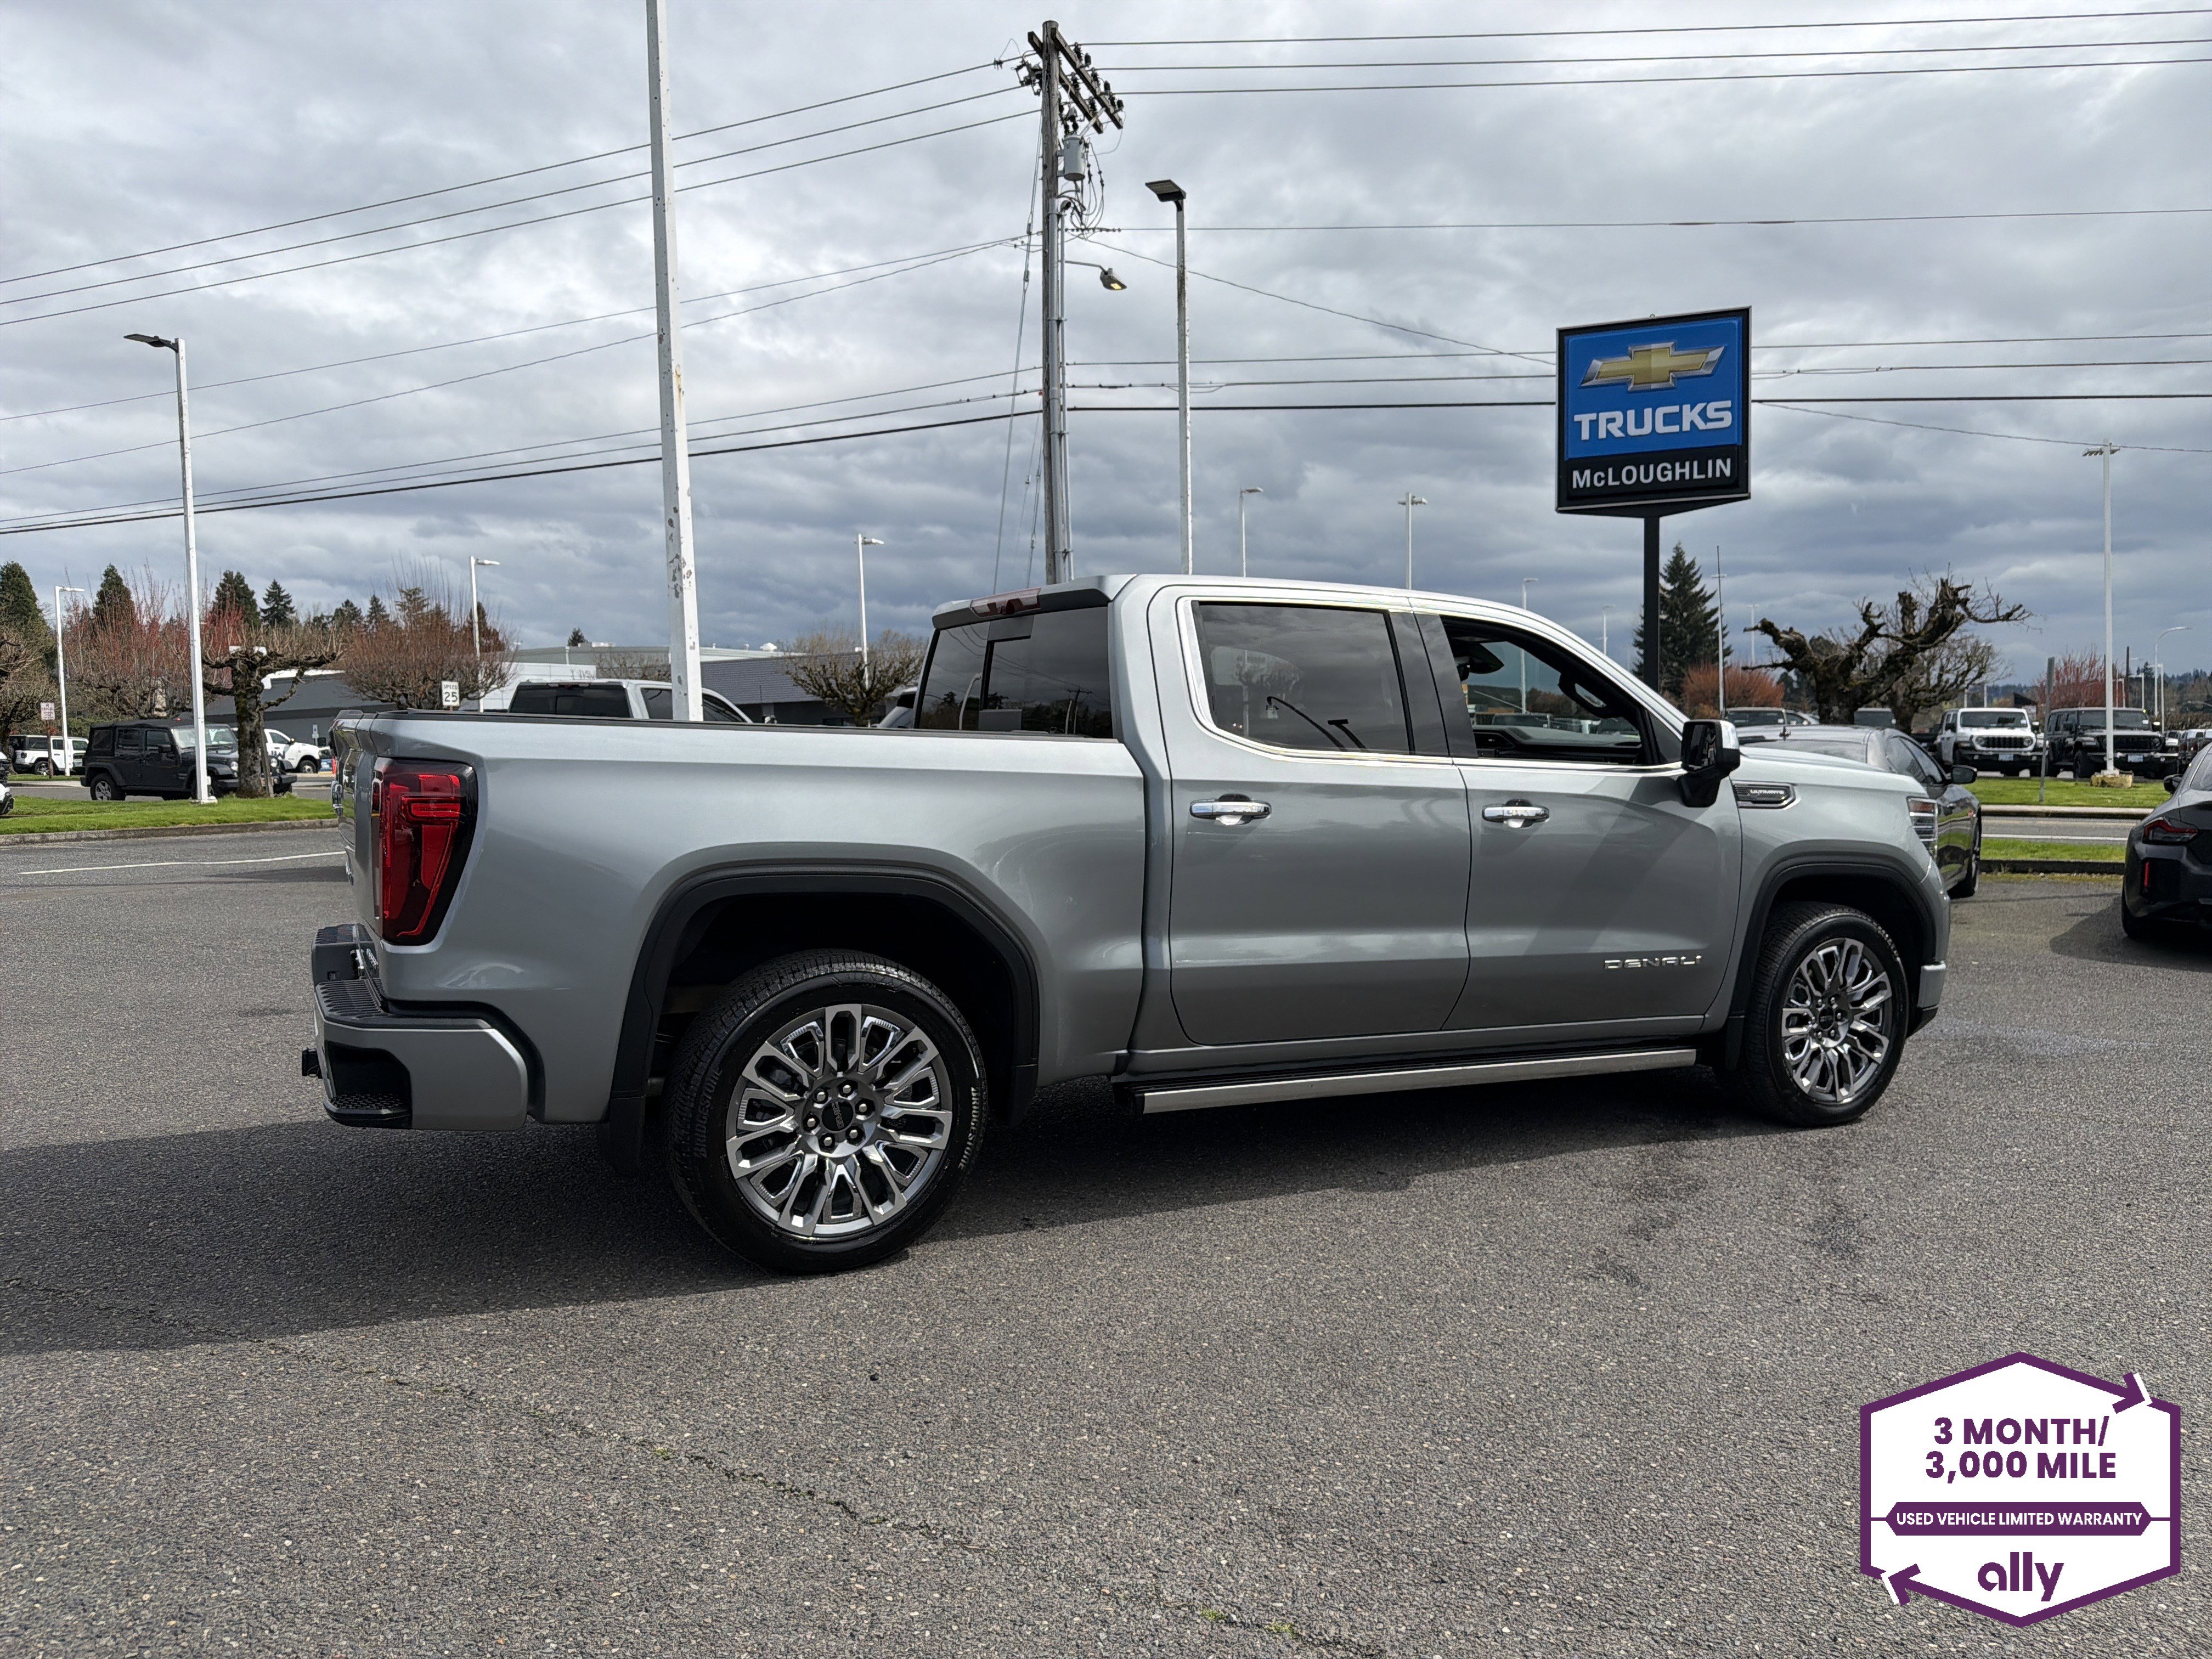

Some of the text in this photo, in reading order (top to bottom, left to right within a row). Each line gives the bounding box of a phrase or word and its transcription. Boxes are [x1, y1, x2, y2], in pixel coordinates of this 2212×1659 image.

[1573, 399, 1732, 441] TRUCKS
[1572, 458, 1731, 489] McLOUGHLIN
[444, 691, 458, 702] 25
[1604, 955, 1702, 969] DENALI
[831, 1102, 844, 1129] GMC
